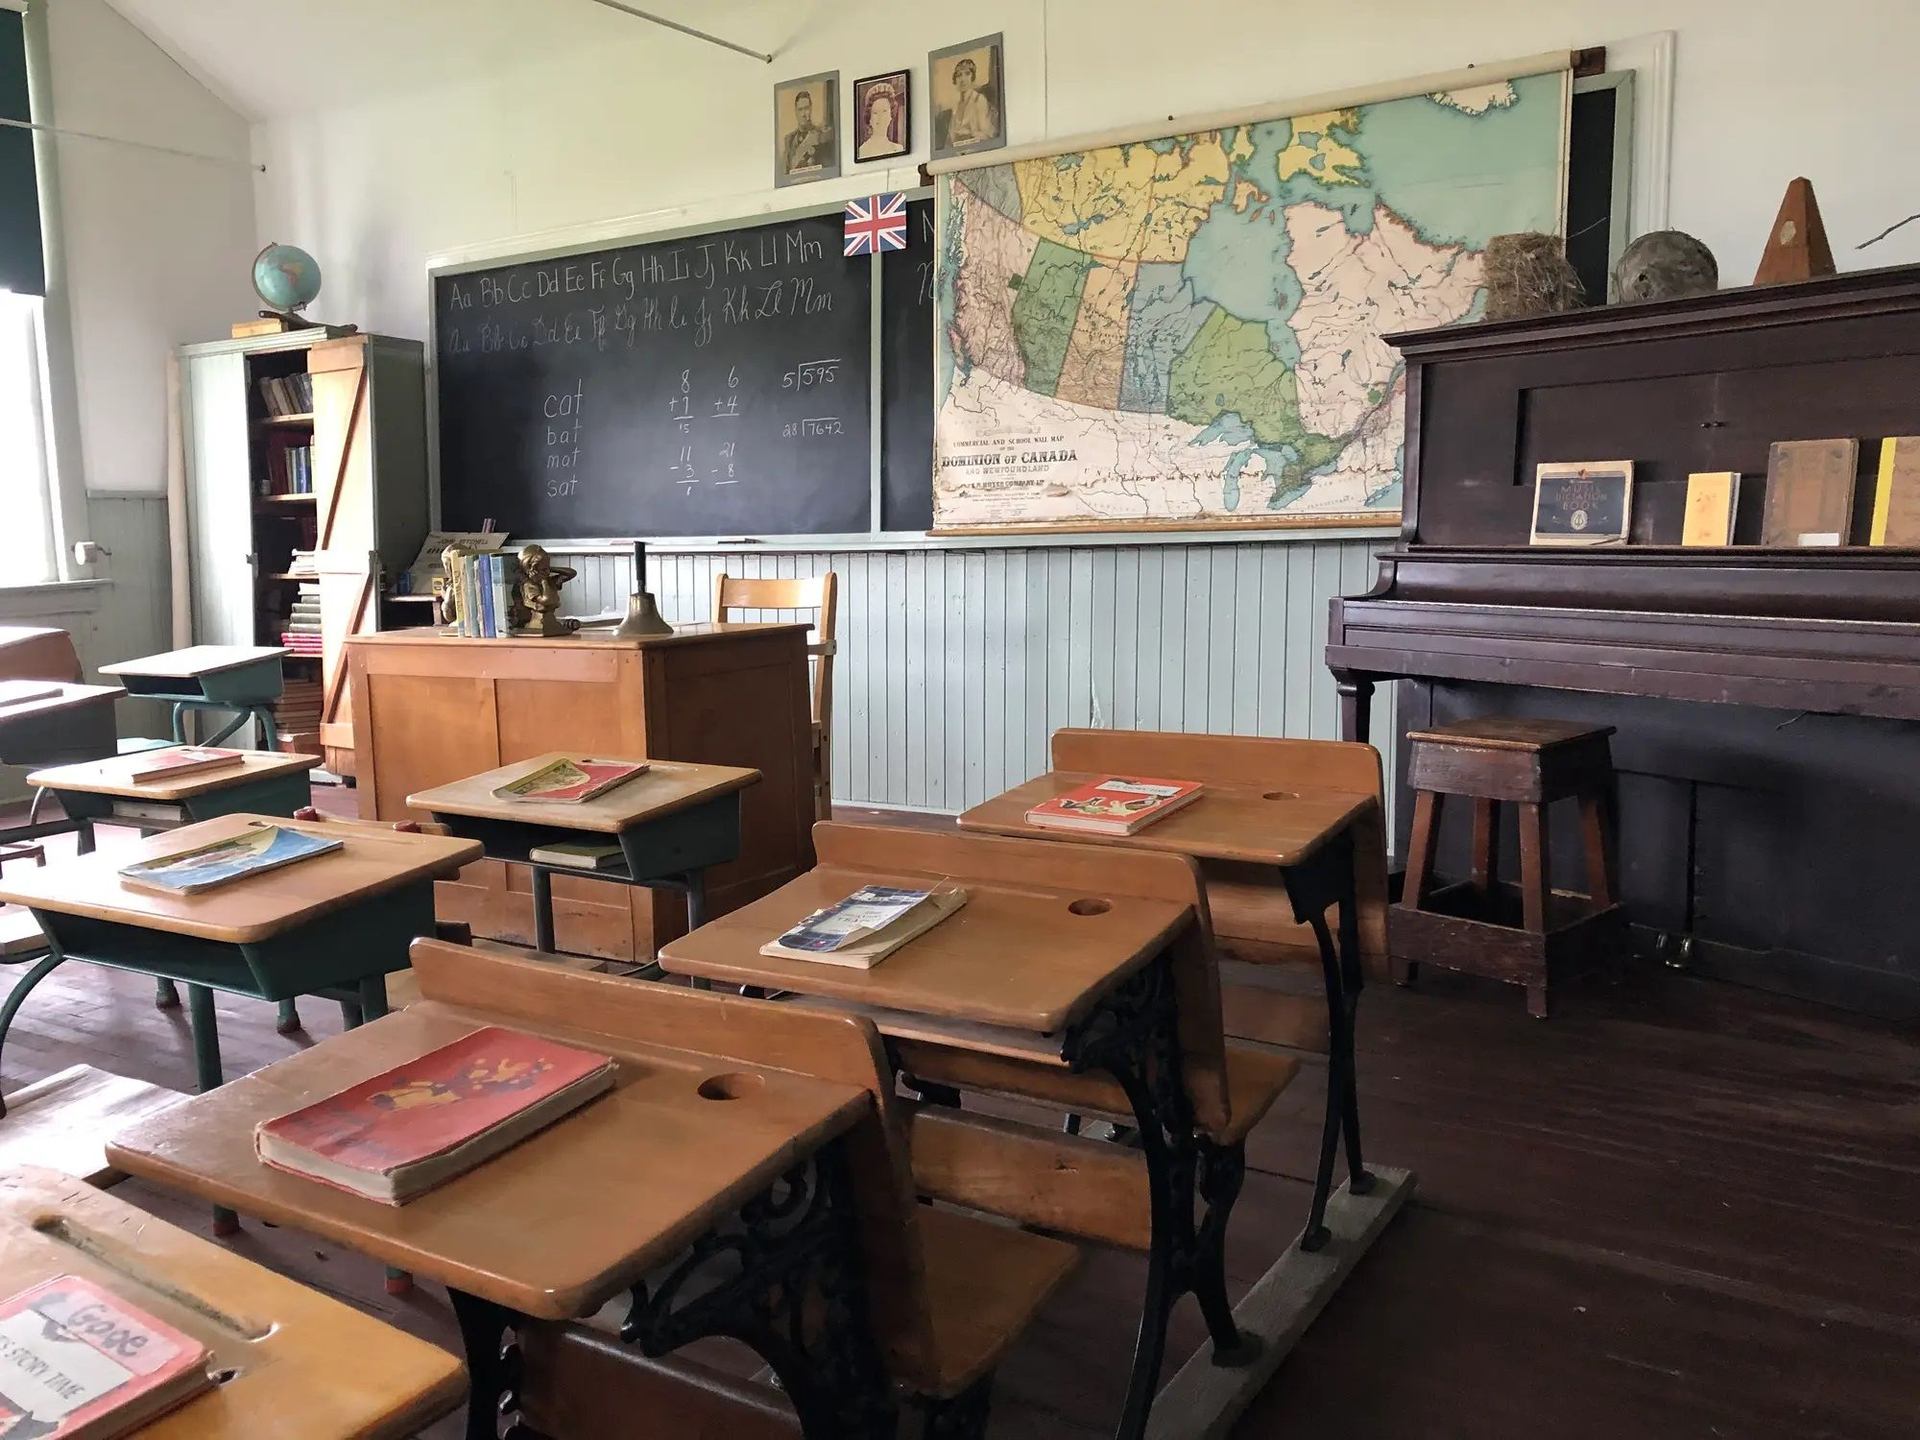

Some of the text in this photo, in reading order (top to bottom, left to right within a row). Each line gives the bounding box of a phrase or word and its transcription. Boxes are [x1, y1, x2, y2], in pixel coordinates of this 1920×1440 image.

[450, 283, 472, 310] Aa
[479, 277, 503, 308] Bb
[507, 274, 531, 303] Cc
[537, 269, 559, 297] Dd
[565, 266, 585, 292] Ee
[591, 262, 606, 290] Ff
[612, 257, 635, 300] Gg
[641, 255, 664, 283] Hh
[696, 243, 716, 289] Jj
[724, 240, 752, 274] Kk
[786, 229, 822, 265] Mm
[681, 369, 690, 393] 8
[728, 366, 739, 388] 6
[544, 378, 583, 418] cat
[547, 418, 583, 445] bat
[807, 421, 844, 435] 7642
[941, 449, 1078, 468] DOMINION OF CANADA
[982, 464, 1050, 475] NEWFOUNDLAND
